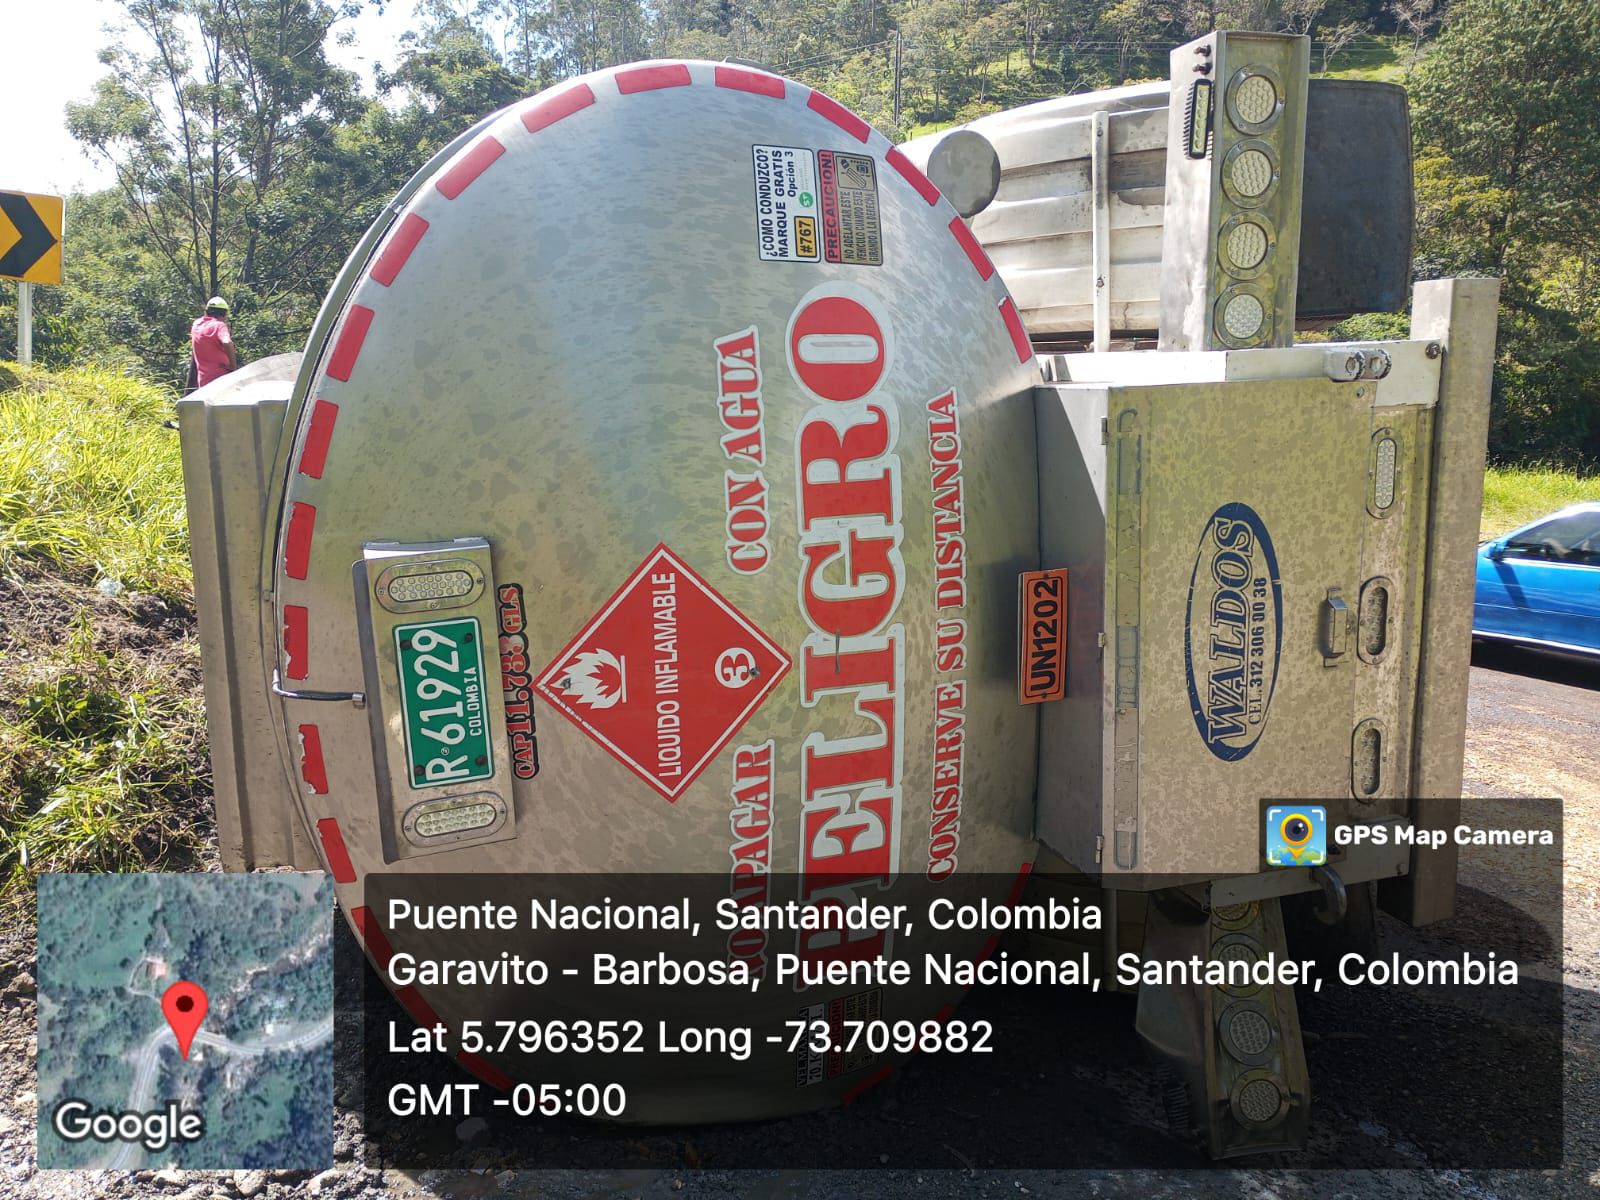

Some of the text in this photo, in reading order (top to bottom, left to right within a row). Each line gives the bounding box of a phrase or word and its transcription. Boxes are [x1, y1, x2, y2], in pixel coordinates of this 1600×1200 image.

[756, 148, 778, 257] ¿COMO CONDUZCO?
[772, 150, 789, 258] MARQUE GRATIS
[785, 161, 799, 198] Opción
[821, 152, 839, 260] PRECAUCION!
[798, 220, 813, 254] #767
[840, 191, 855, 260] NO ADELANTAR ESTE
[714, 325, 771, 576] CON AGUA
[1207, 516, 1255, 744] WALDOS
[1253, 577, 1268, 598] 38
[651, 572, 682, 778] LIQUIDO INFLAMABLE
[720, 652, 749, 682] 3
[785, 280, 906, 992] PELIGRO
[927, 386, 968, 882] CONSERVE SU DISTANCIA
[1030, 579, 1059, 692] UN1202
[1250, 660, 1264, 689] 312
[1251, 627, 1265, 656] 306
[463, 666, 483, 737] COLOMBIA
[1247, 688, 1263, 726] CEL.
